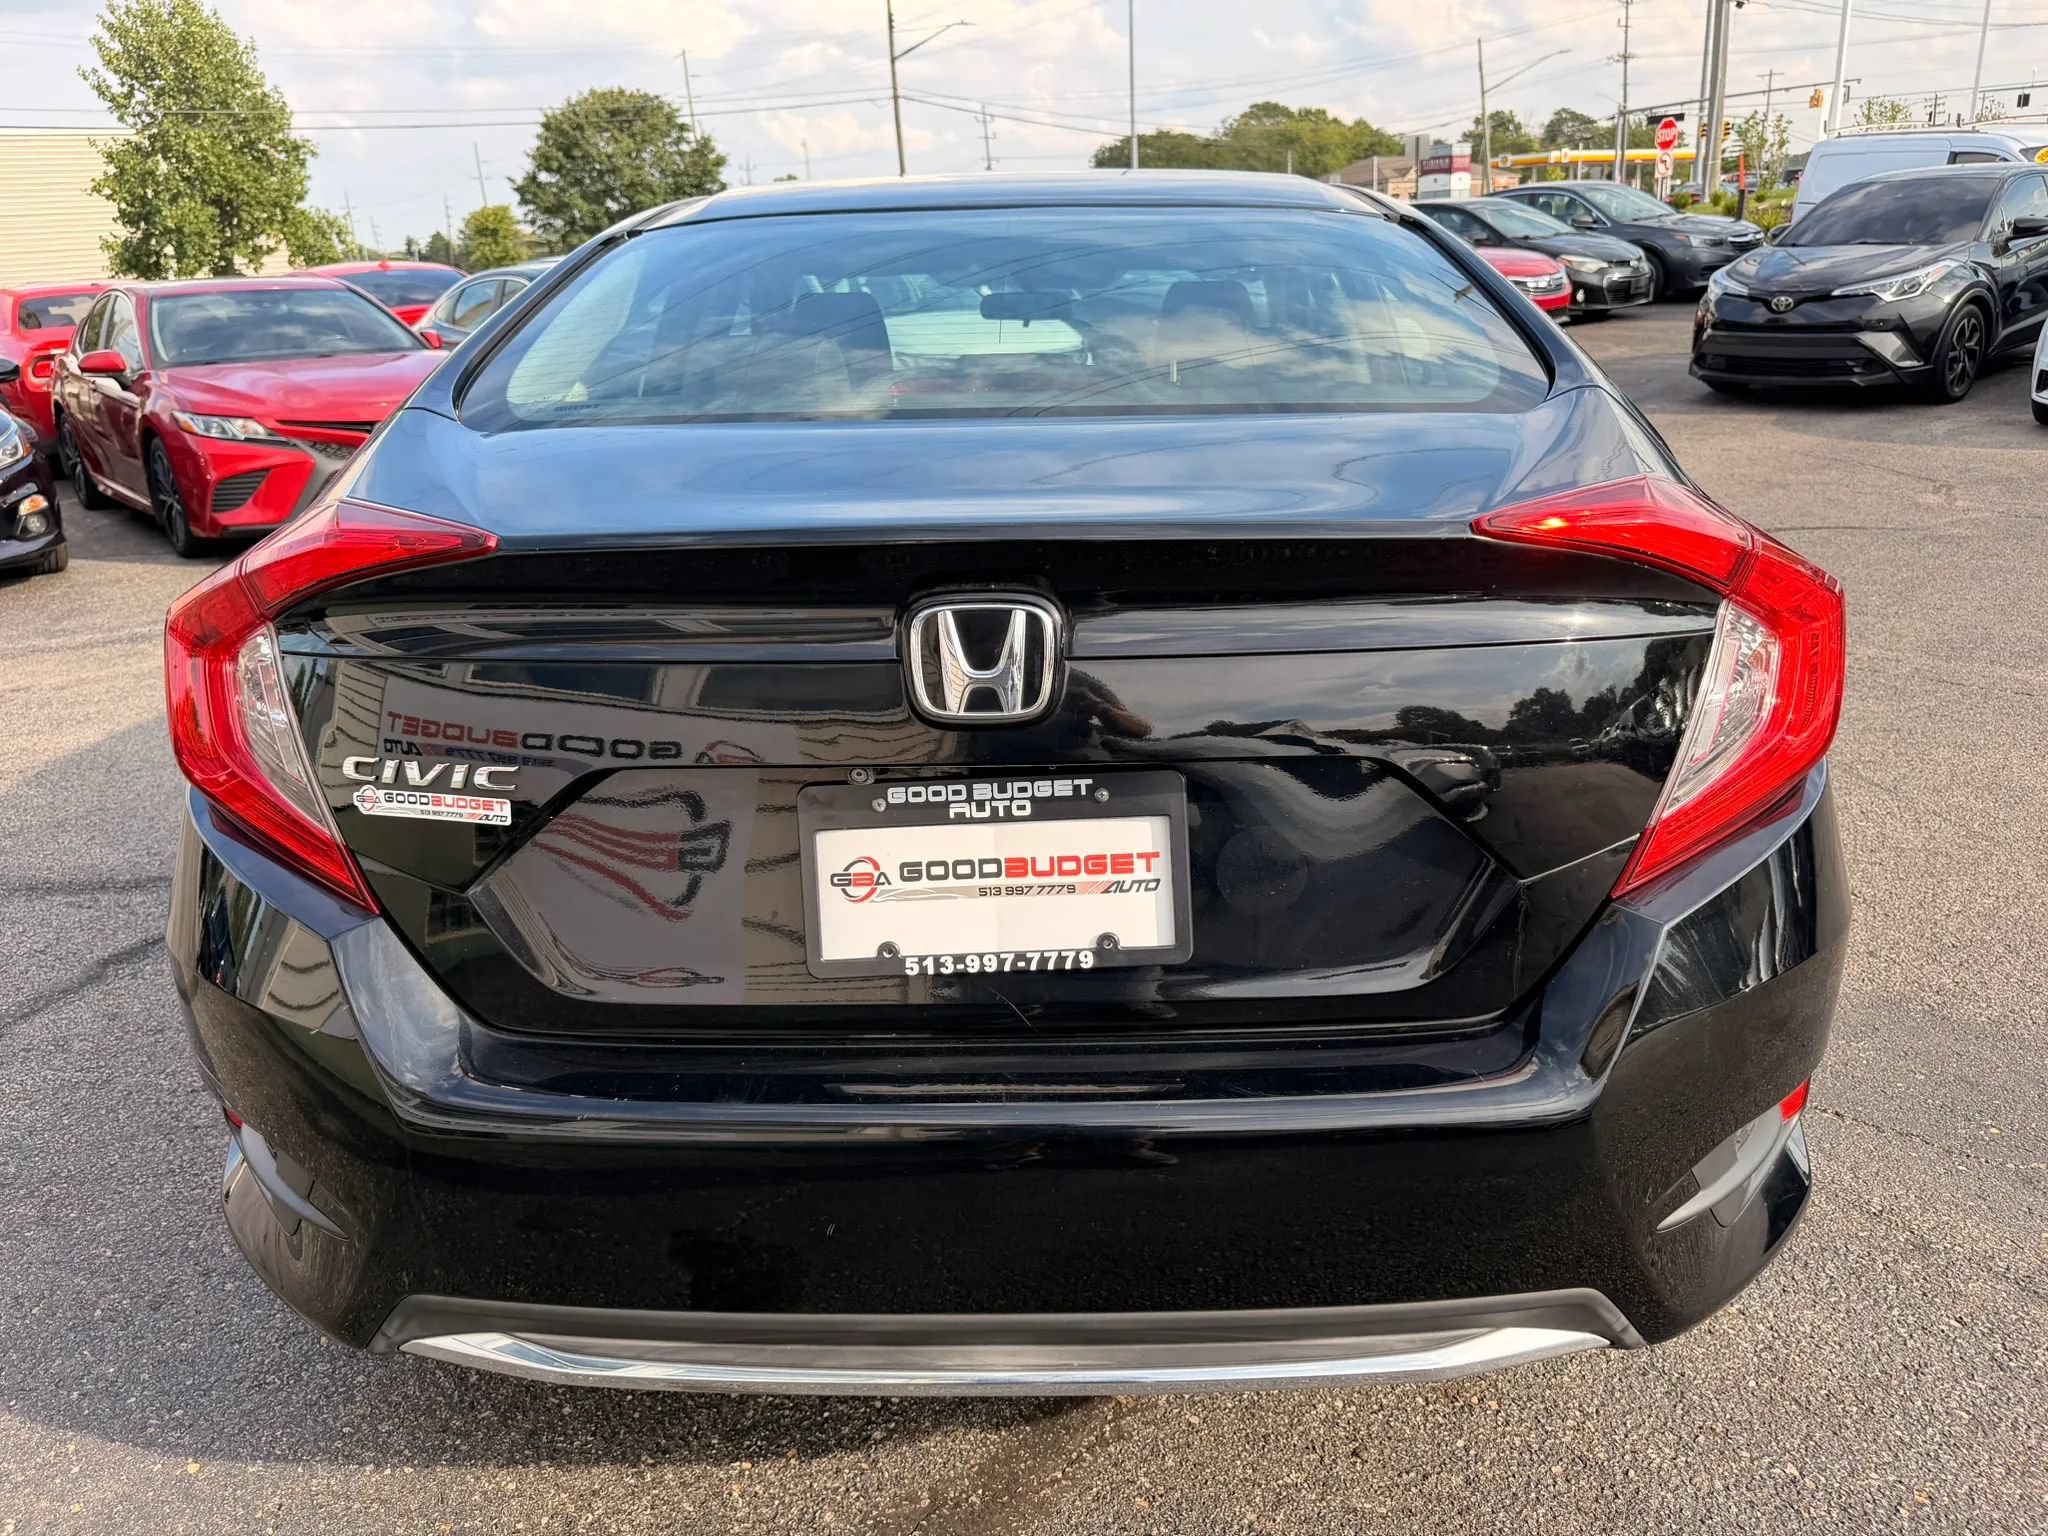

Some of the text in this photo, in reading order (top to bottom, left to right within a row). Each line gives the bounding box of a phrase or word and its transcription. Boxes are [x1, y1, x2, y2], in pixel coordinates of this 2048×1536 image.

[1657, 128, 1677, 142] STOP
[342, 756, 520, 791] CIVIC
[887, 778, 1093, 803] GOOD BUDGET
[949, 800, 1032, 818] AUTO
[478, 814, 508, 822] AUTO
[978, 883, 1076, 897] 513 997 7779
[1105, 878, 1161, 894] AUTO
[904, 950, 1095, 976] 513-997-7779
